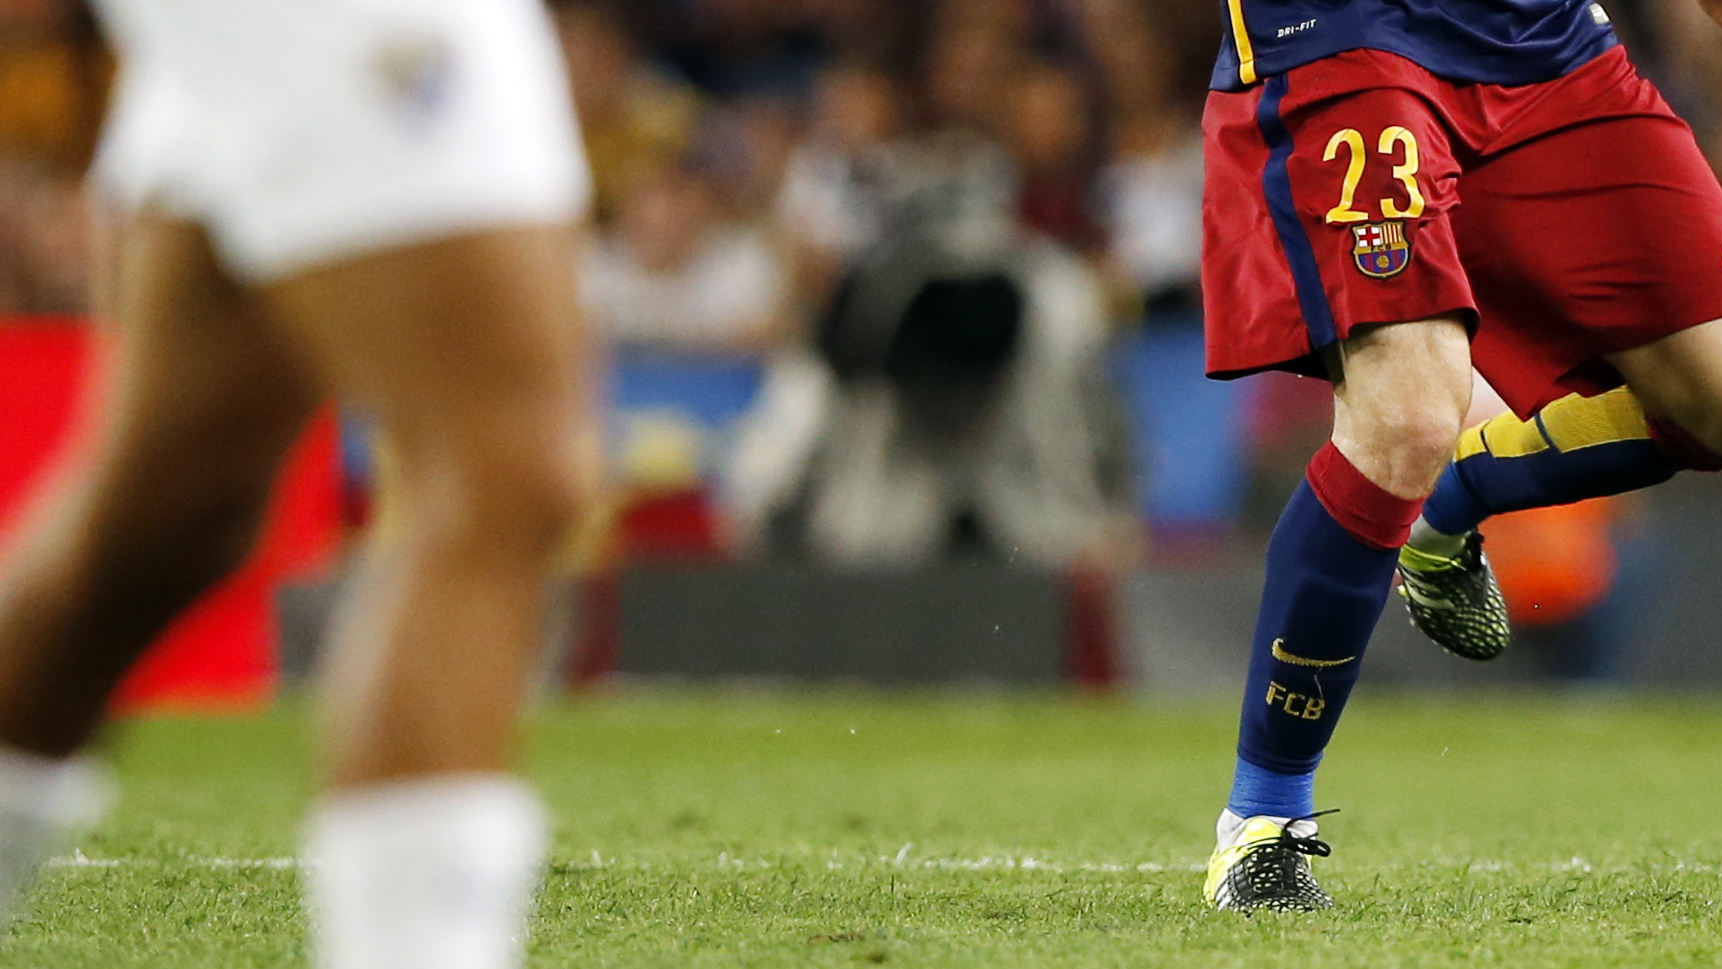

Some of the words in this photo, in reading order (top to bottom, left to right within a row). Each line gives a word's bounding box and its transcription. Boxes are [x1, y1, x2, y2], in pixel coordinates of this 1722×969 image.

[1277, 18, 1316, 38] DRI-FIT
[1322, 126, 1425, 224] 23
[1265, 680, 1325, 720] FCB
